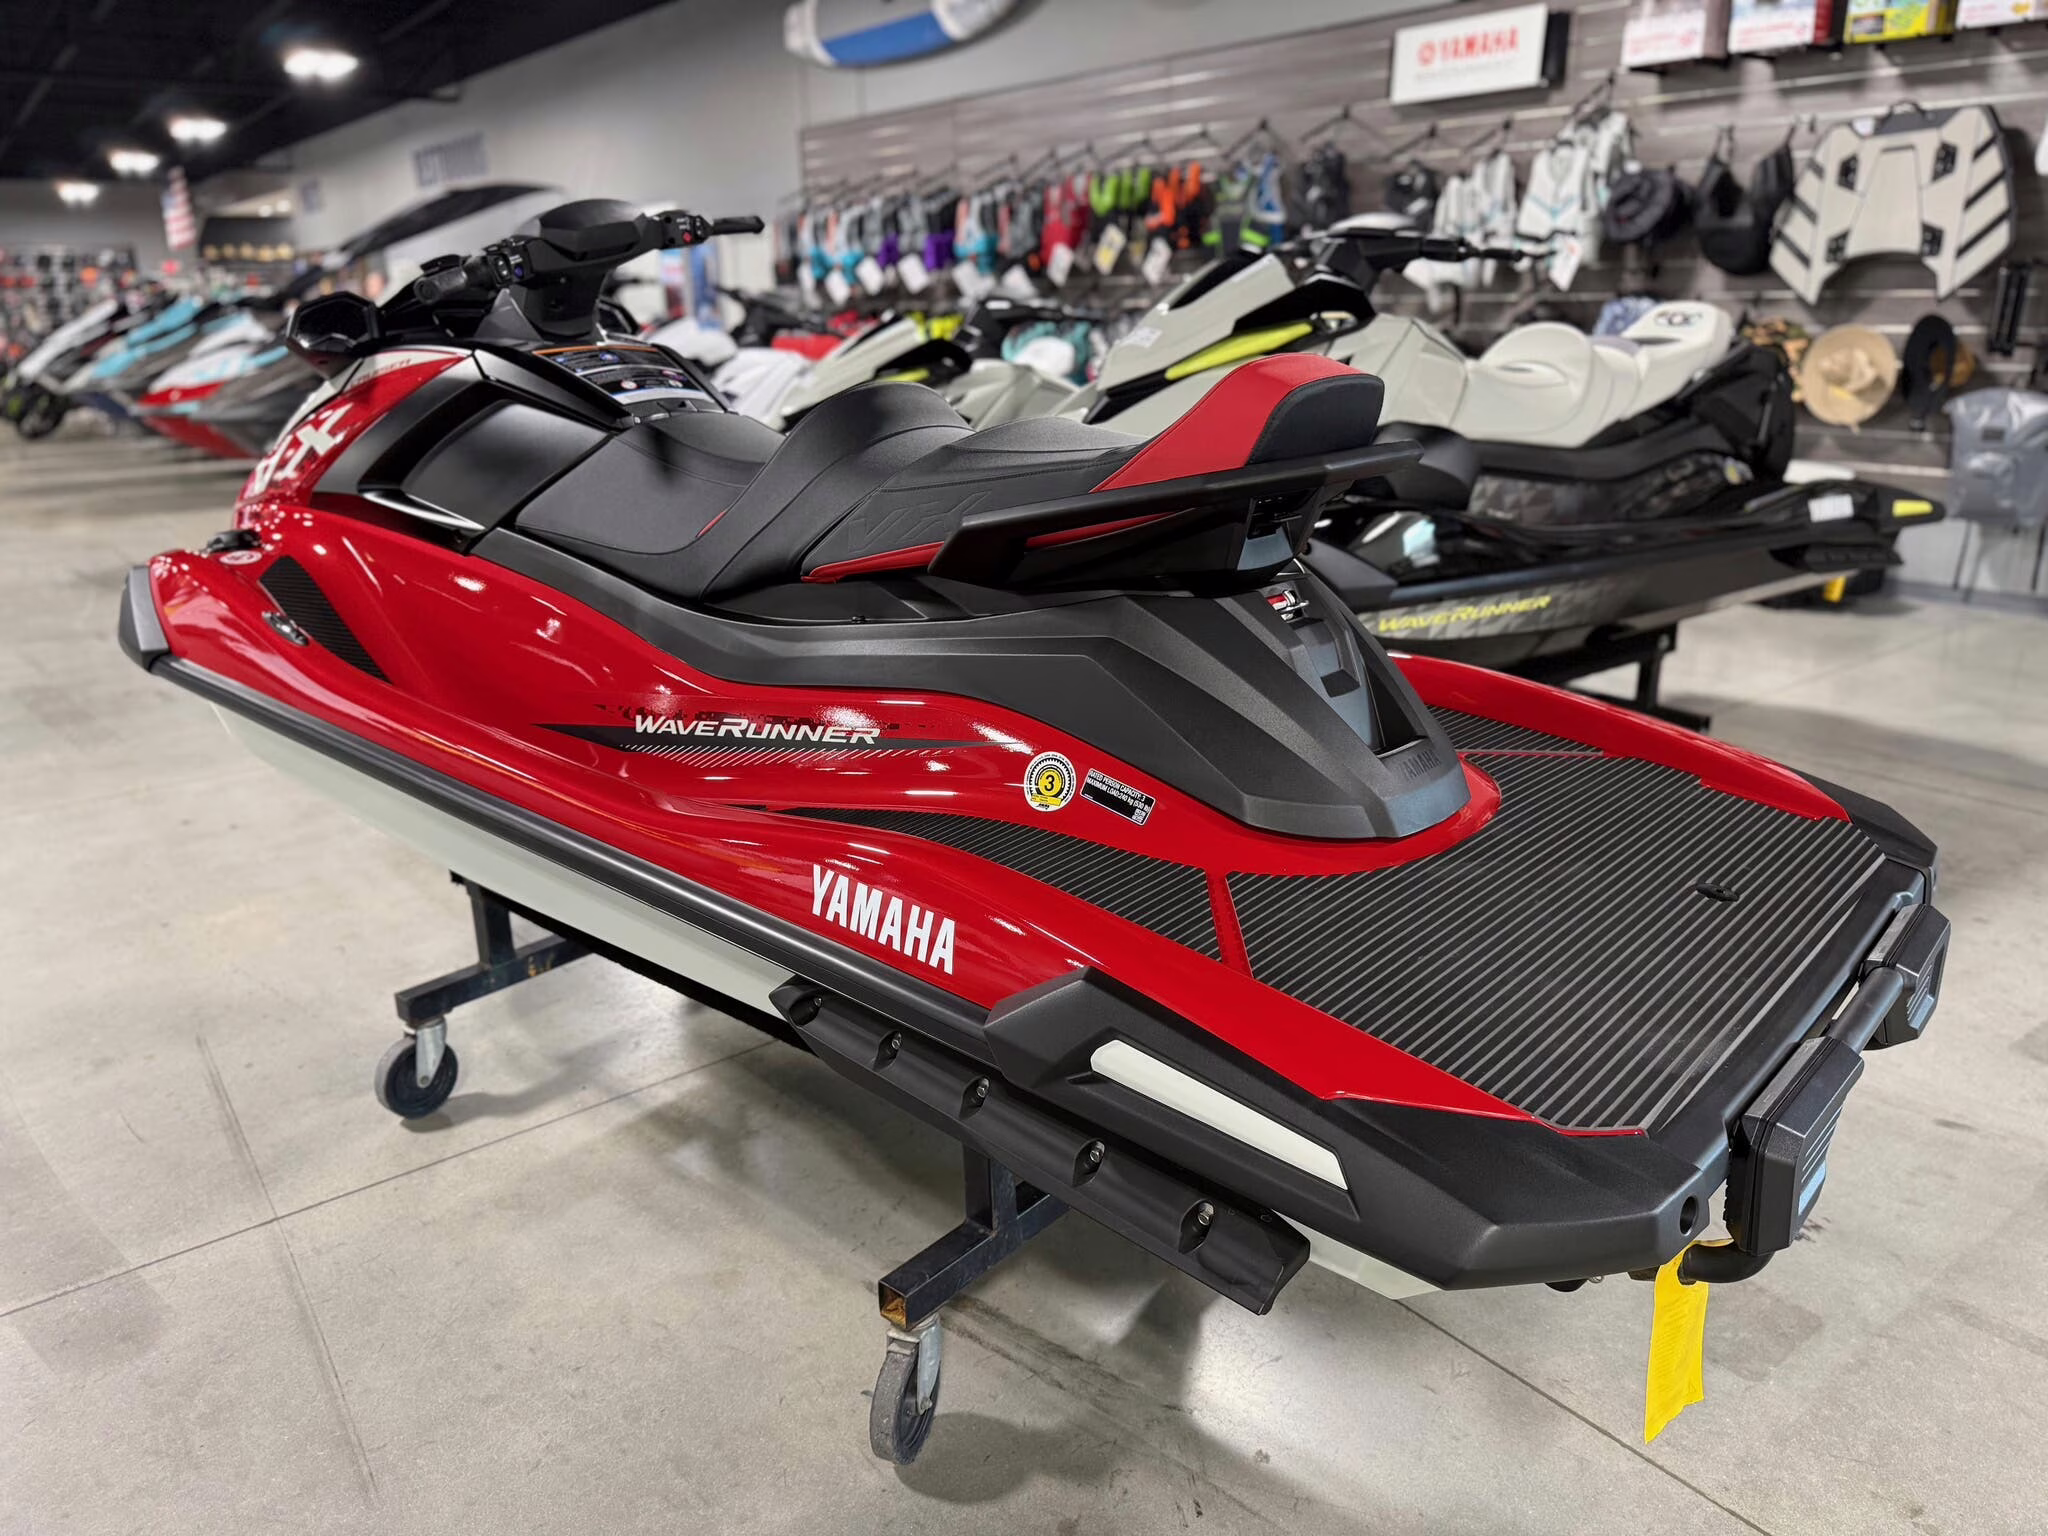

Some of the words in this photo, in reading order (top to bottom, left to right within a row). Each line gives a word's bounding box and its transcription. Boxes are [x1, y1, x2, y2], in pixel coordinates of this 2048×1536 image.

[1441, 27, 1519, 61] YAMAHA
[1401, 750, 1442, 781] YAMAHA
[1044, 774, 1055, 792] 3
[1102, 777, 1121, 791] PERSON
[811, 863, 956, 976] YAMAHA
